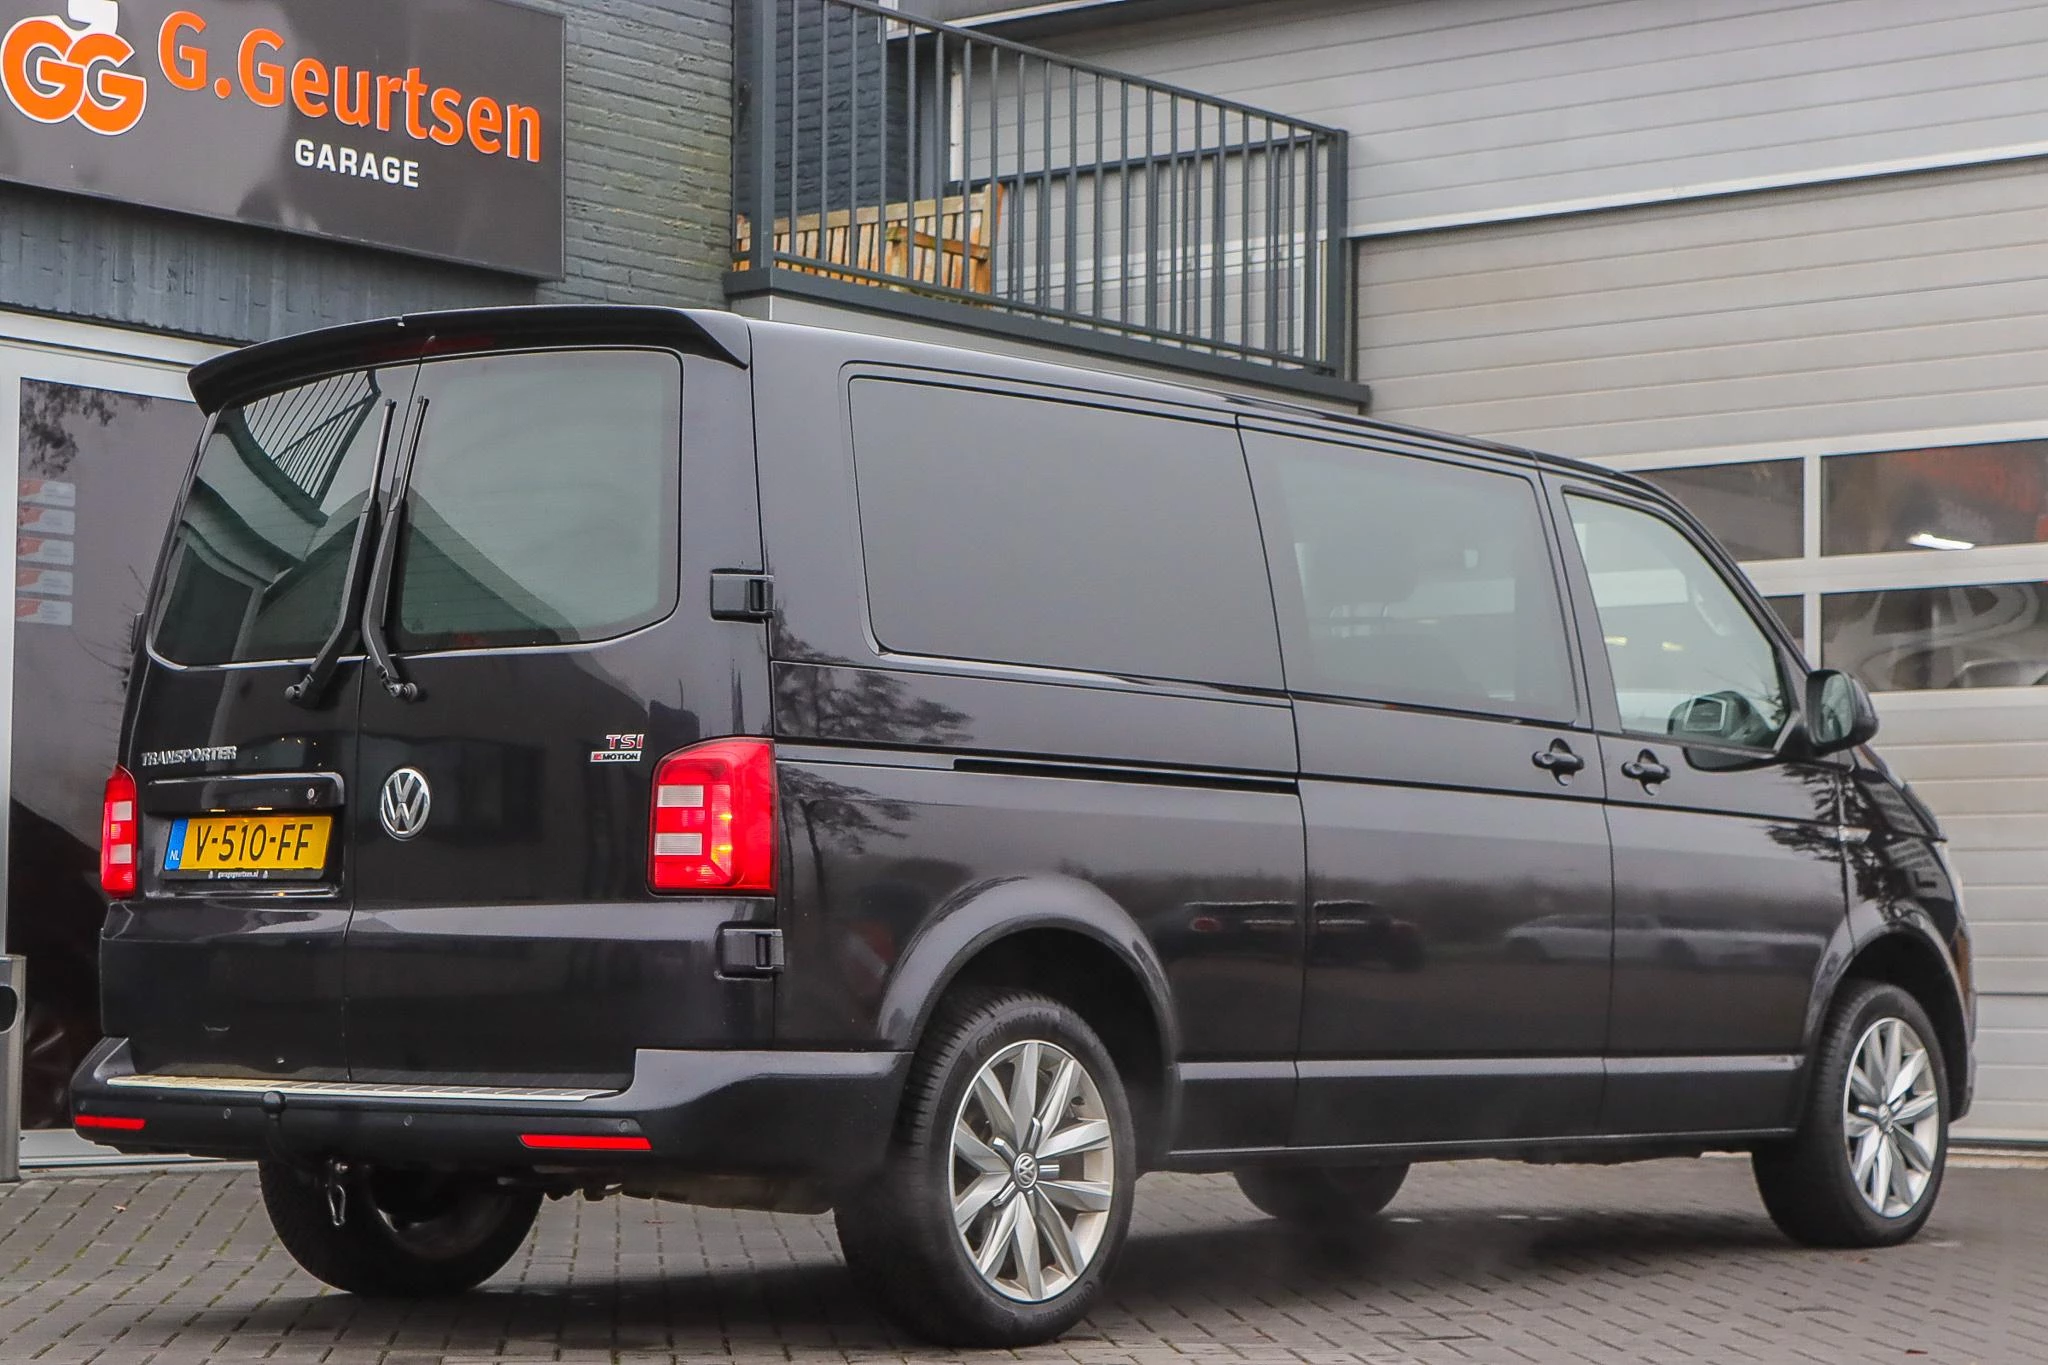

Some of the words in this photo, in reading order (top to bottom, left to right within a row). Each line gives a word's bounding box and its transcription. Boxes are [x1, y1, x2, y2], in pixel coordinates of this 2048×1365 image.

[294, 138, 419, 189] GARAGE
[605, 733, 645, 749] TSI
[141, 745, 237, 767] TRANSPORTER
[195, 823, 313, 862] V-510-FF
[169, 849, 180, 861] NL
